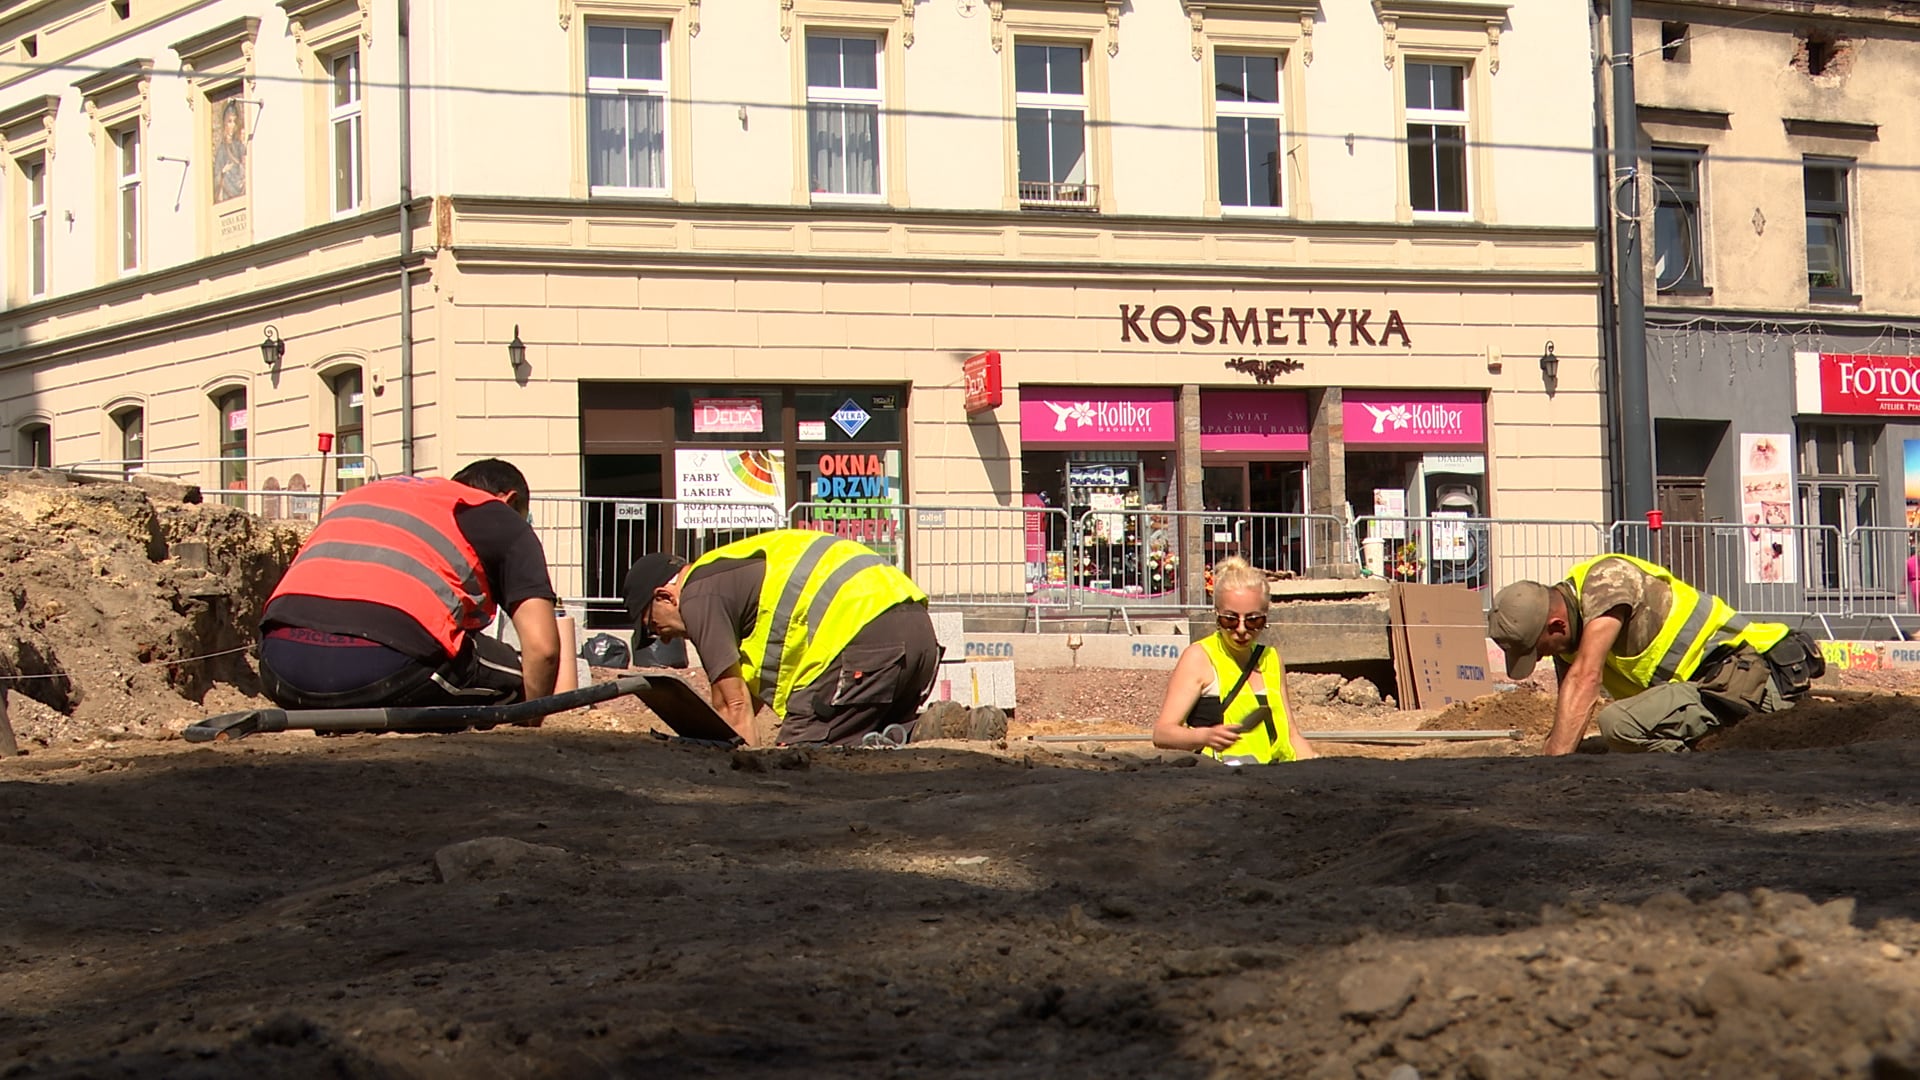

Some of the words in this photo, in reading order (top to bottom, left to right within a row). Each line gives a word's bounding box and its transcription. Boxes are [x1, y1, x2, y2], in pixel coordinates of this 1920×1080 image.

[1119, 304, 1412, 348] KOSMETYKA
[703, 405, 755, 425] DELTA
[1098, 400, 1152, 427] Koliber
[1227, 409, 1269, 421] ŚWIAT
[1413, 404, 1463, 429] Koliber
[1200, 425, 1251, 434] APACHU
[819, 454, 881, 476] OKNA
[683, 473, 719, 482] FARBY
[683, 488, 732, 497] LAKIERY
[817, 476, 890, 498] DRZWI
[683, 502, 772, 510] ROZPUSZCZALNIK
[813, 498, 893, 520] ROLETY
[683, 516, 719, 524] CHEMIA
[720, 516, 775, 524] BUDOWLAN
[965, 642, 1014, 657] PREFA
[1131, 643, 1179, 658] PREFA
